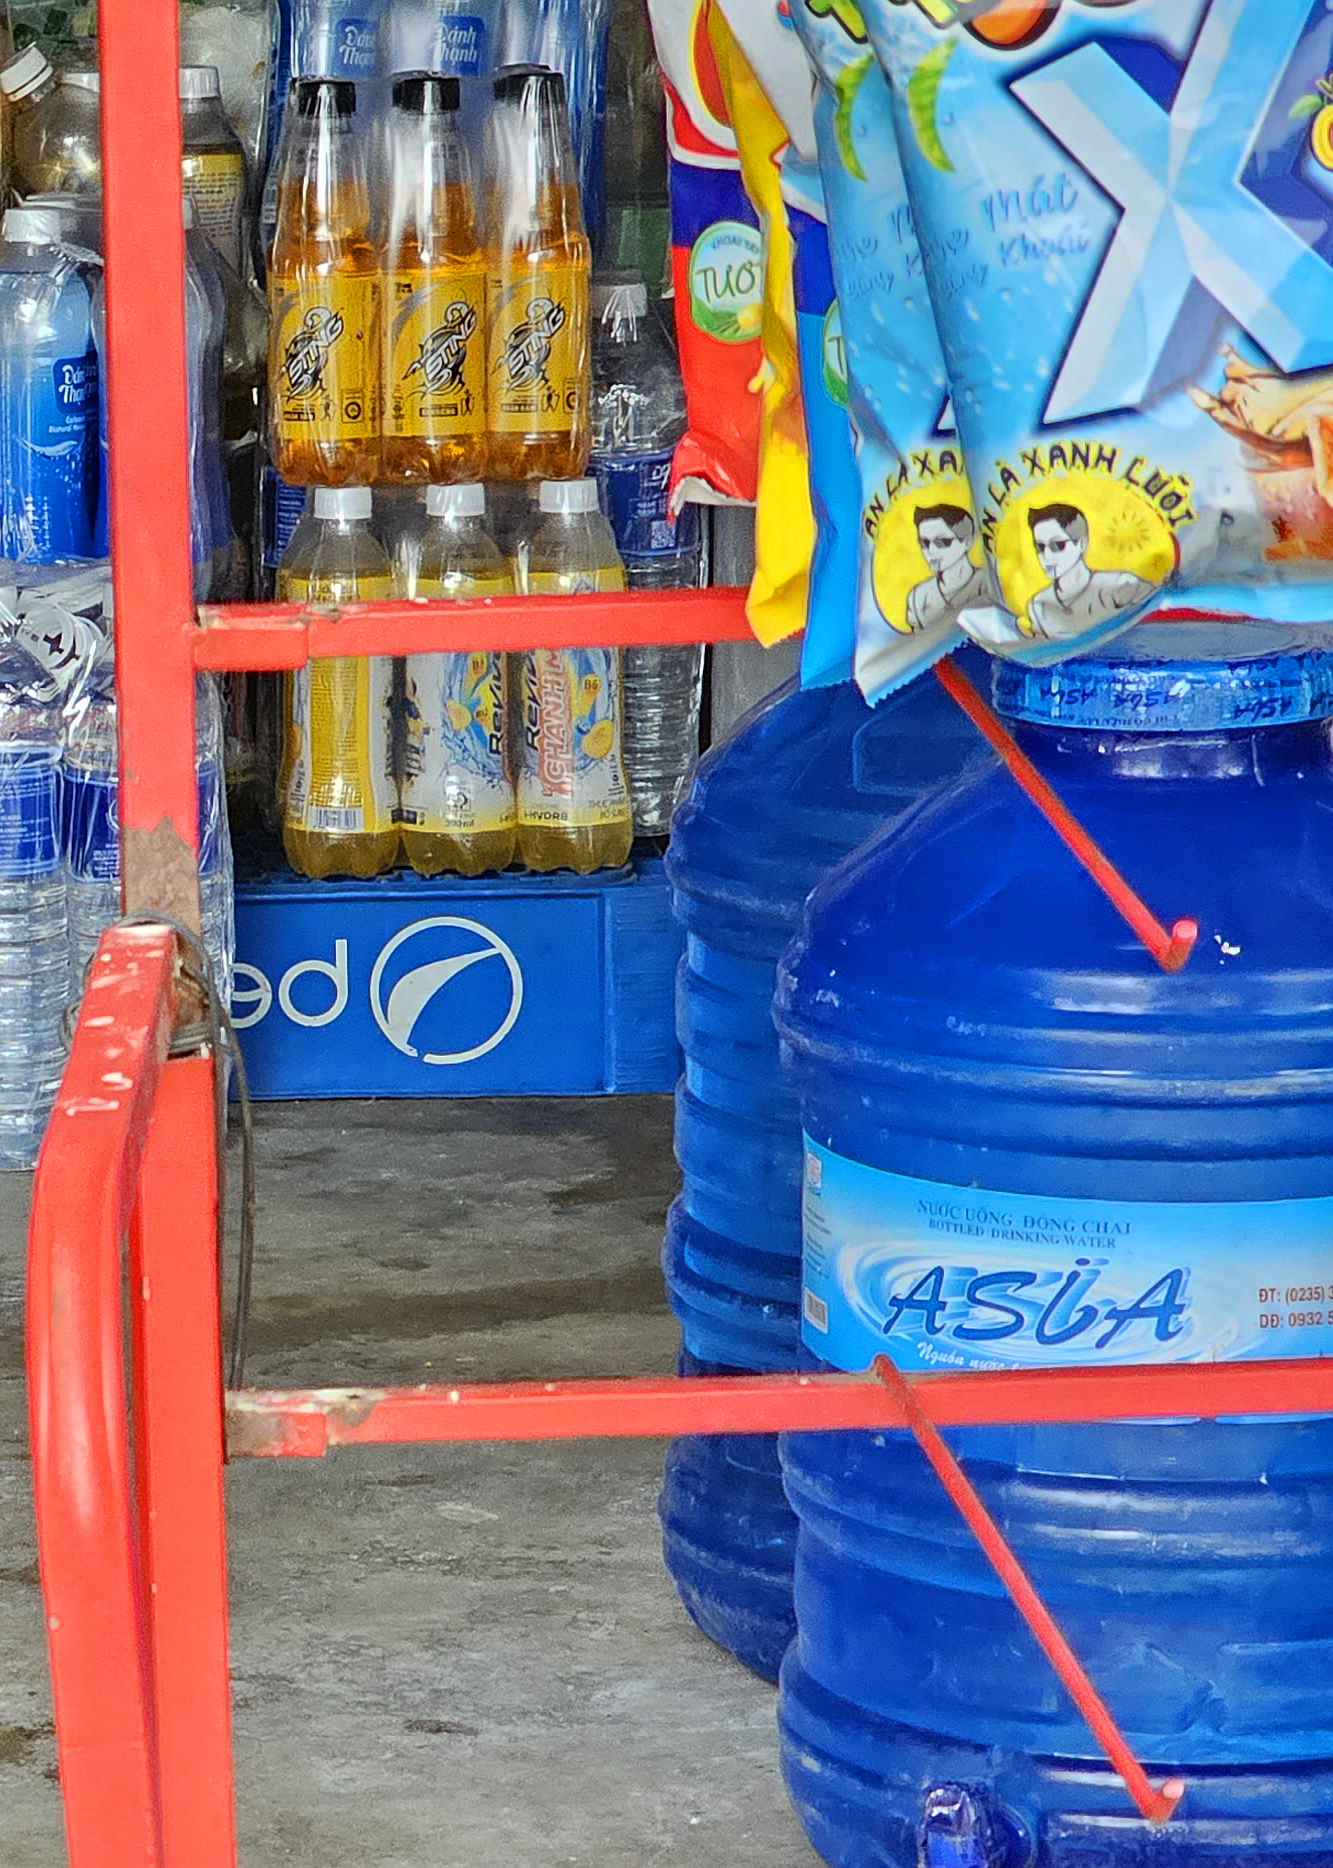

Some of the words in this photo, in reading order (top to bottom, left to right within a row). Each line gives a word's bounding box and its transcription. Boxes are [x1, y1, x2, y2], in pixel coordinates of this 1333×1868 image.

[1022, 443, 1117, 476] XANH
[929, 1217, 985, 1237] BOTTLED
[991, 1227, 1060, 1246] DRINKING
[1064, 1234, 1117, 1249] WATER
[1082, 1219, 1132, 1236] CHAI
[1258, 1287, 1281, 1303] ĐT:
[1285, 1285, 1325, 1306] (0235)
[1288, 1311, 1323, 1328] 0932
